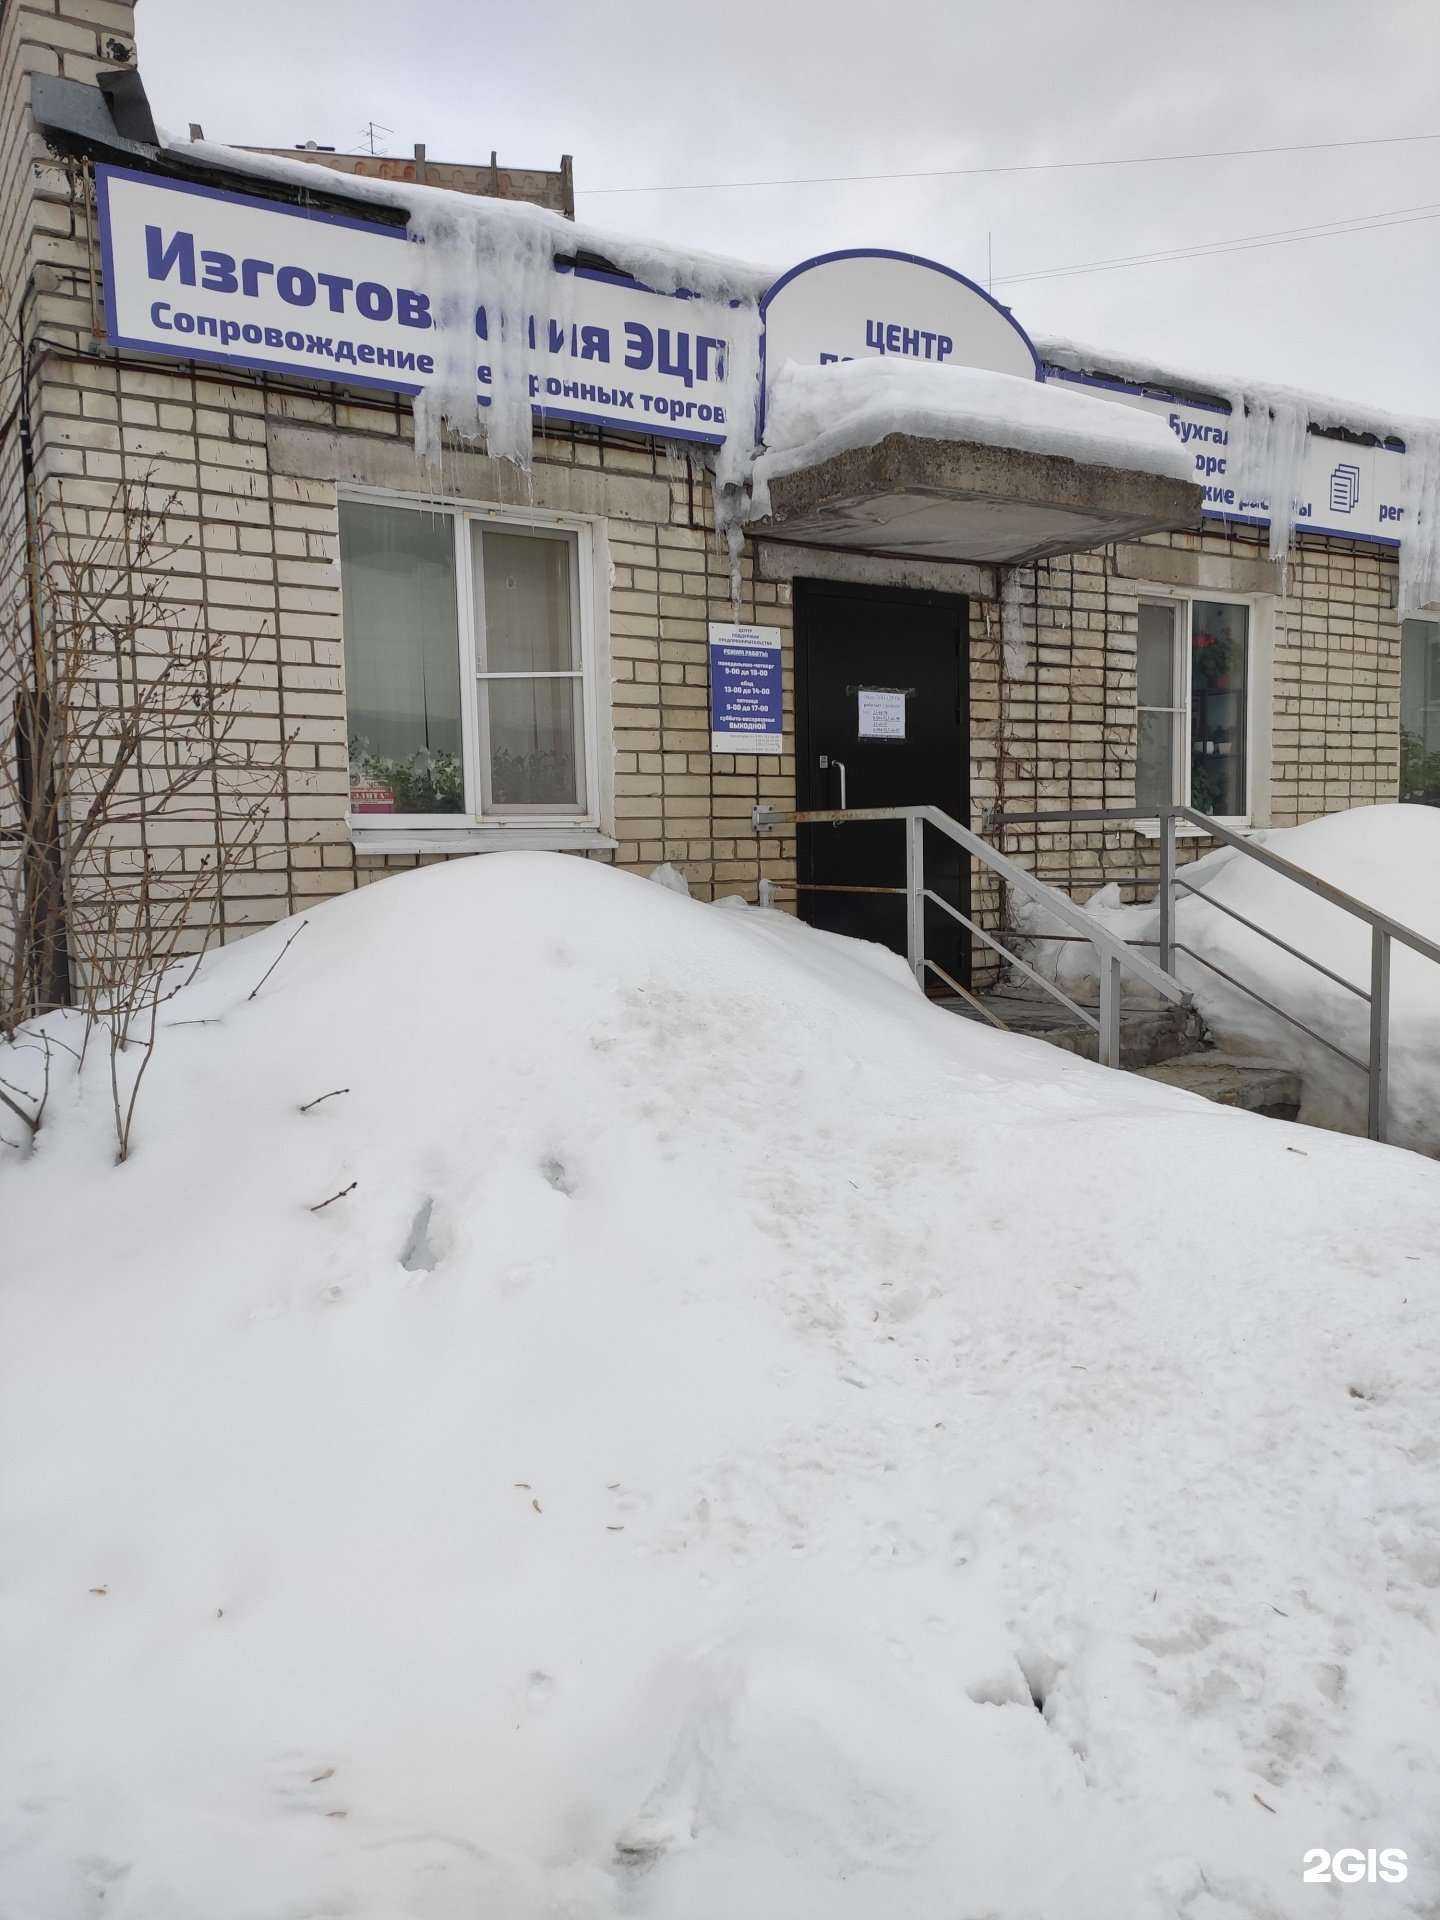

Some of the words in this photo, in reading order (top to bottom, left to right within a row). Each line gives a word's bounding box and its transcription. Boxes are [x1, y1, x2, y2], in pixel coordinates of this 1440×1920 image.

[150, 301, 434, 374] Сопровождение
[865, 319, 953, 362] ЦЕНТР
[624, 321, 729, 388] ЭЦП
[724, 685, 742, 693] 13-00
[742, 687, 751, 695] до
[752, 686, 770, 695] 14-00
[742, 705, 751, 713] до
[751, 704, 769, 712] 17-00
[729, 722, 767, 730] ВЫХОДНОЙ
